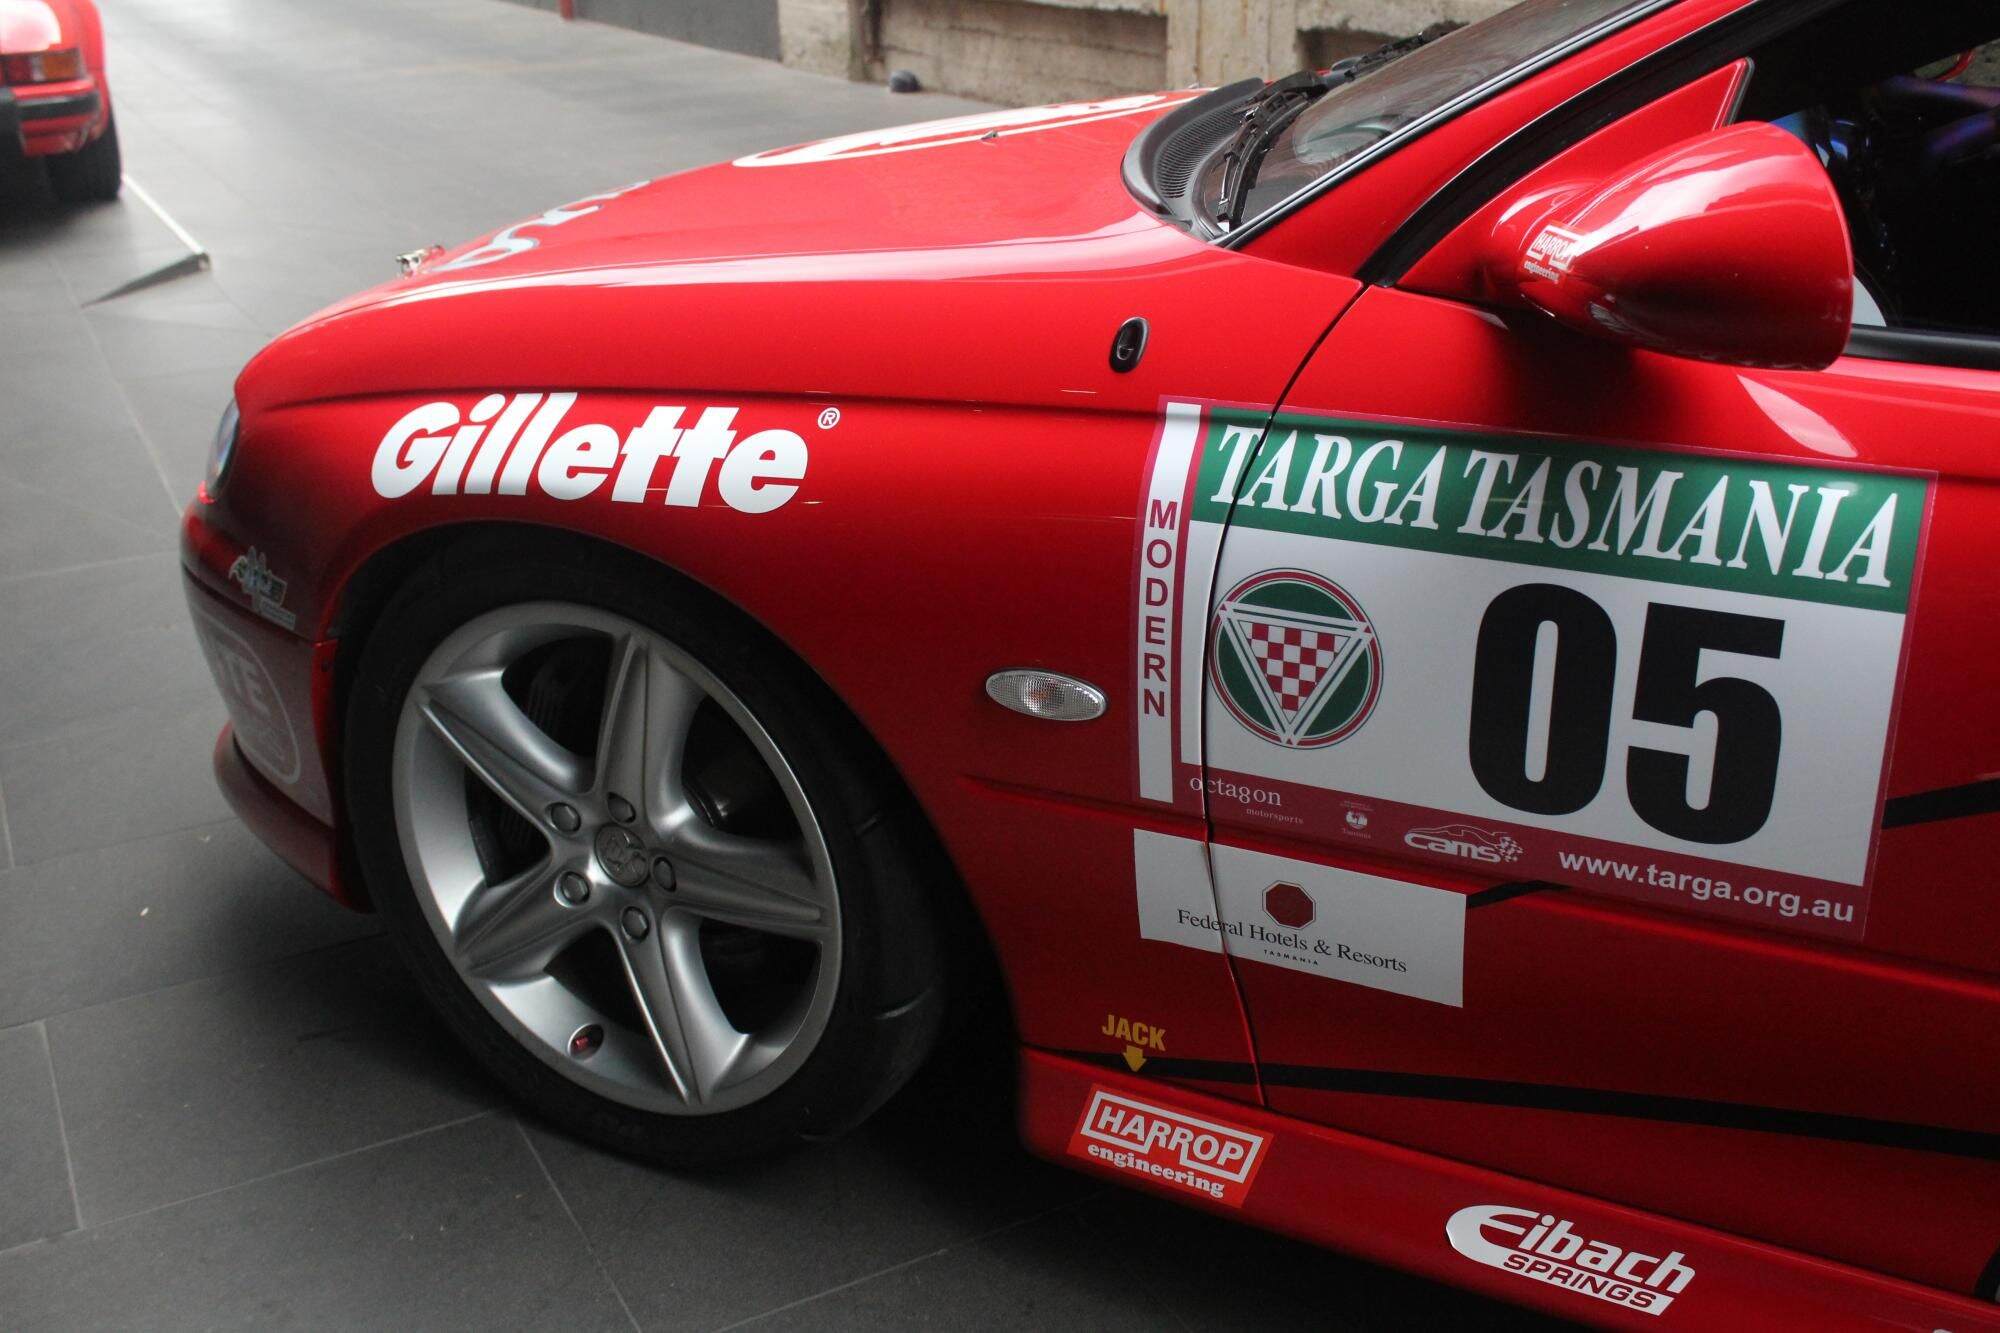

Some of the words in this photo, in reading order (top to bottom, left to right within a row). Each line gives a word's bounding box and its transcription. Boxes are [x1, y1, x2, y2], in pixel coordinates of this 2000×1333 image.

[370, 391, 809, 514] Gillette
[1210, 424, 1448, 530] TARGA
[1456, 449, 1899, 588] TASMANIA
[1143, 498, 1178, 718] MODERN
[1468, 582, 1786, 846] 05
[1189, 776, 1282, 807] octagon
[1246, 807, 1304, 825] motorsports
[1558, 850, 1855, 923] www.targa.org.au
[1176, 908, 1244, 937] Federal
[1248, 924, 1308, 951] Hotels
[1313, 938, 1333, 956] &
[1336, 943, 1408, 974] Resorts
[1263, 948, 1319, 966] TASMANIA
[1101, 1013, 1167, 1052] JACK
[1096, 1106, 1245, 1167] HARROP
[1087, 1142, 1226, 1199] engineering
[1445, 1204, 1697, 1295] Eibach
[1502, 1253, 1658, 1309] SPRINGS
